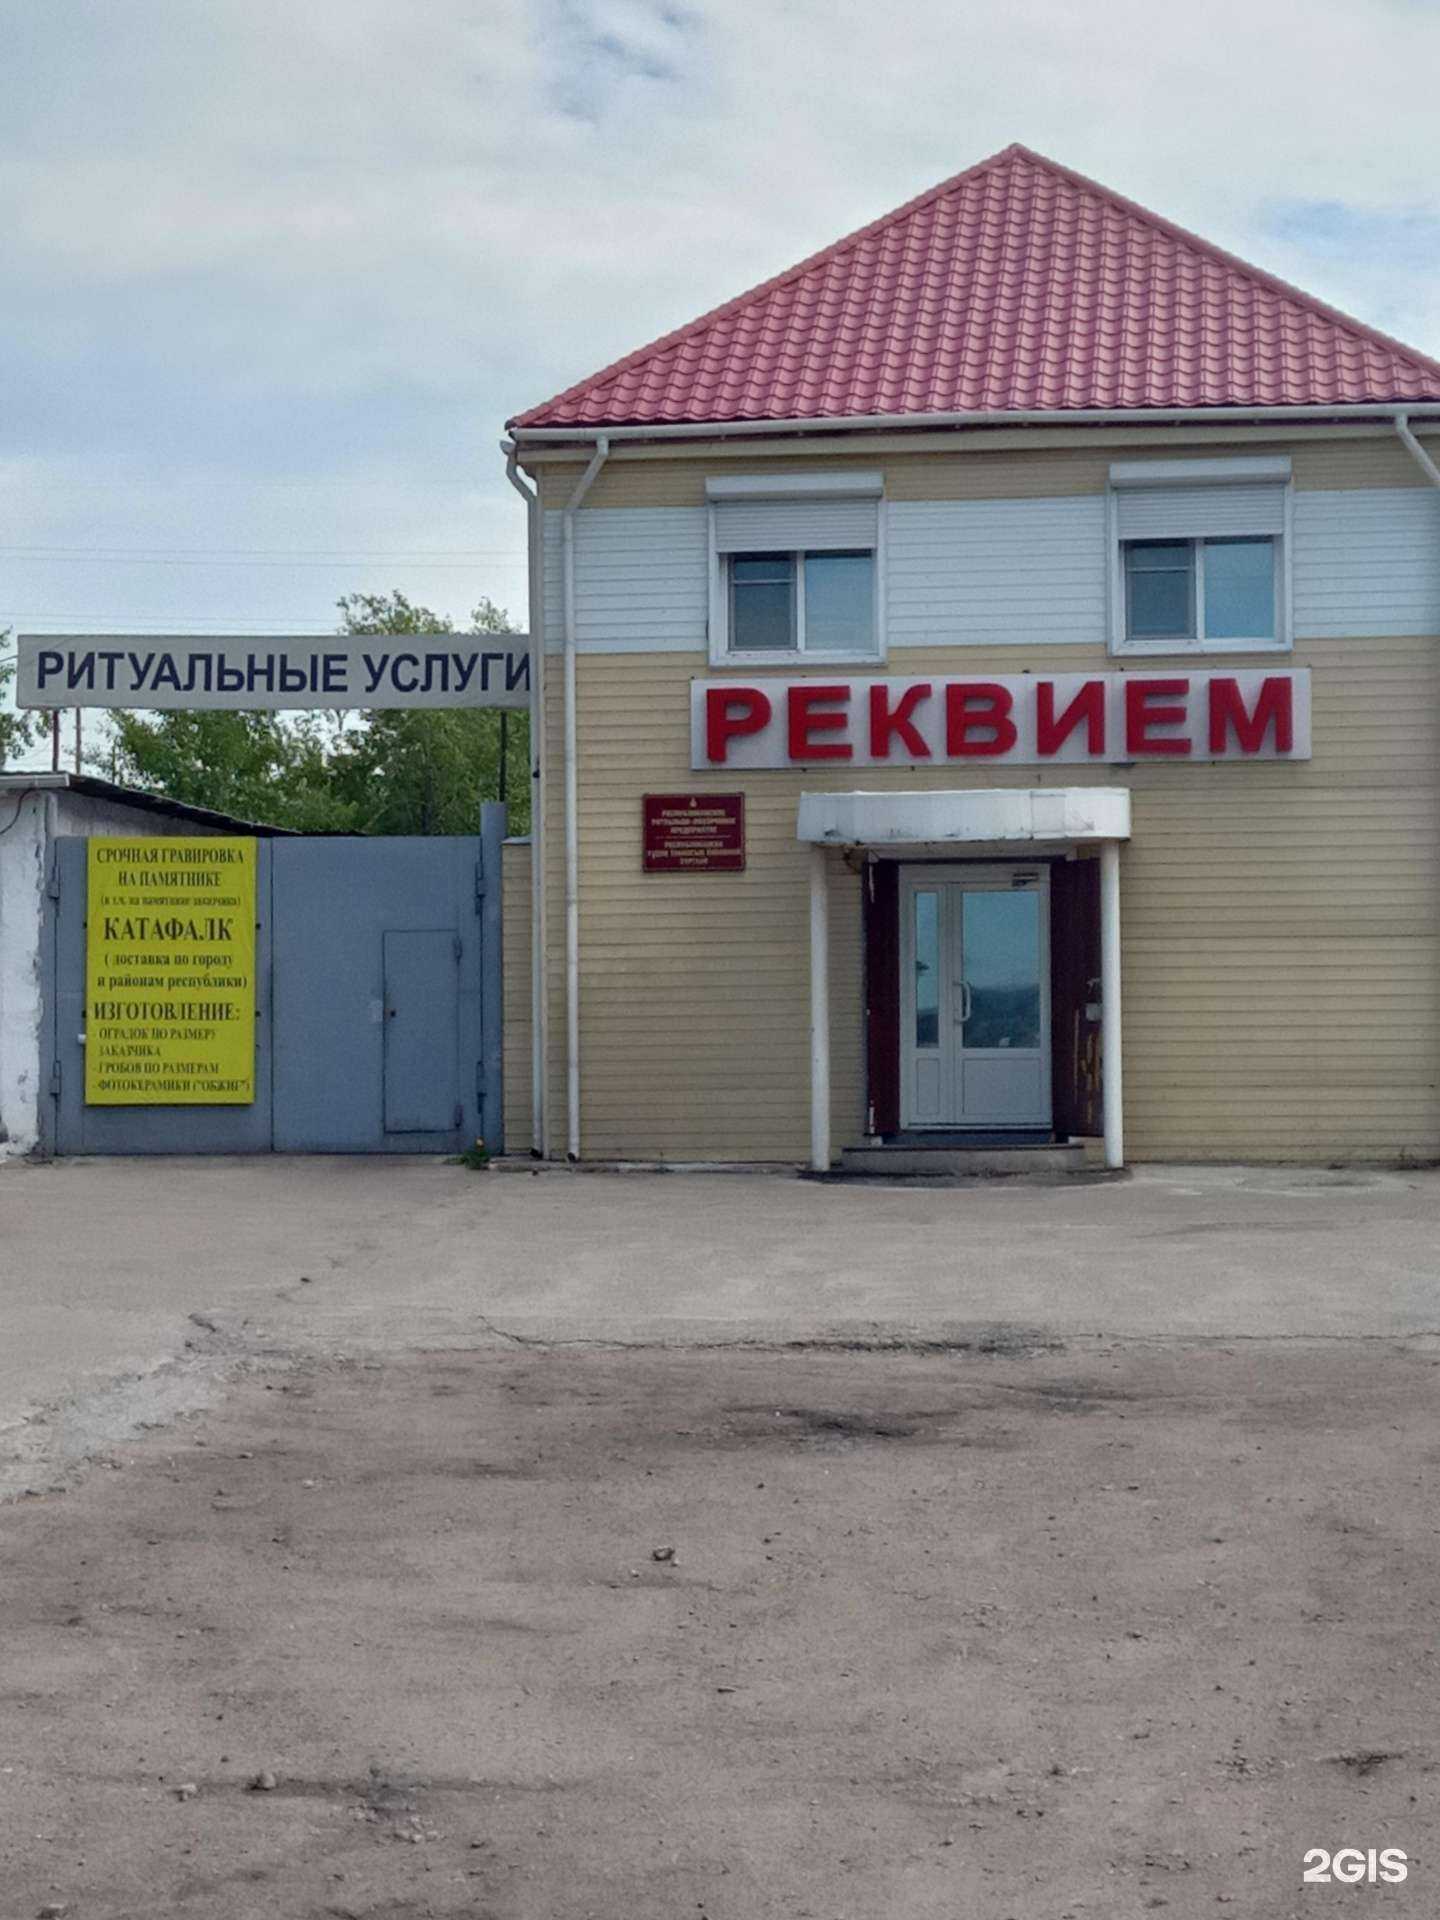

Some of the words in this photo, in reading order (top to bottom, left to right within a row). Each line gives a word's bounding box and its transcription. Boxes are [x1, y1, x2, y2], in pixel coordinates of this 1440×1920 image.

[37, 651, 348, 692] РИТУАЛЬНЫЕ
[364, 652, 530, 692] УСЛУГИ
[706, 677, 1293, 763] РЕКВИЕМ
[97, 848, 158, 863] СРОЧНАЯ
[161, 848, 244, 863] ГРАВИРОВКА
[118, 871, 136, 887] НА
[140, 871, 222, 887] ПАМЯТНИКЕ
[104, 918, 233, 941] КАТАФАЛК
[174, 954, 189, 965] по
[97, 976, 105, 987] и
[109, 974, 164, 991] районам
[167, 973, 248, 991] республики)
[94, 1002, 241, 1021] ИЗГОТОВЛЕНИЕ:
[152, 1027, 168, 1039] ПО
[99, 1045, 161, 1057] ЗАКАЗЧИКА
[144, 1061, 160, 1073] ПО
